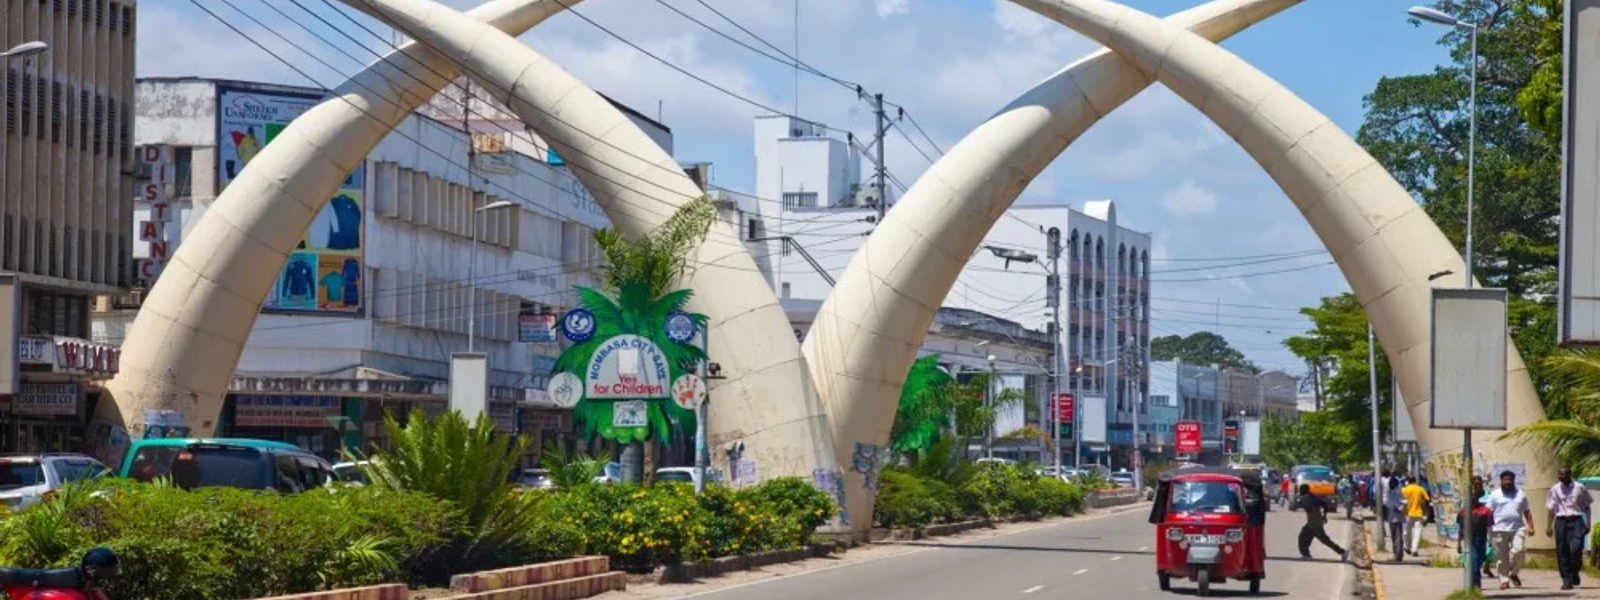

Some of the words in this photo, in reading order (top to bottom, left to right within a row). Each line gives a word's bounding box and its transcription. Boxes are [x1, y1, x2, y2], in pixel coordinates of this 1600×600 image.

[590, 339, 628, 380] MOMBASA
[631, 339, 655, 354] CITY
[618, 373, 638, 385] Yes
[593, 383, 609, 395] for
[612, 383, 663, 395] Children
